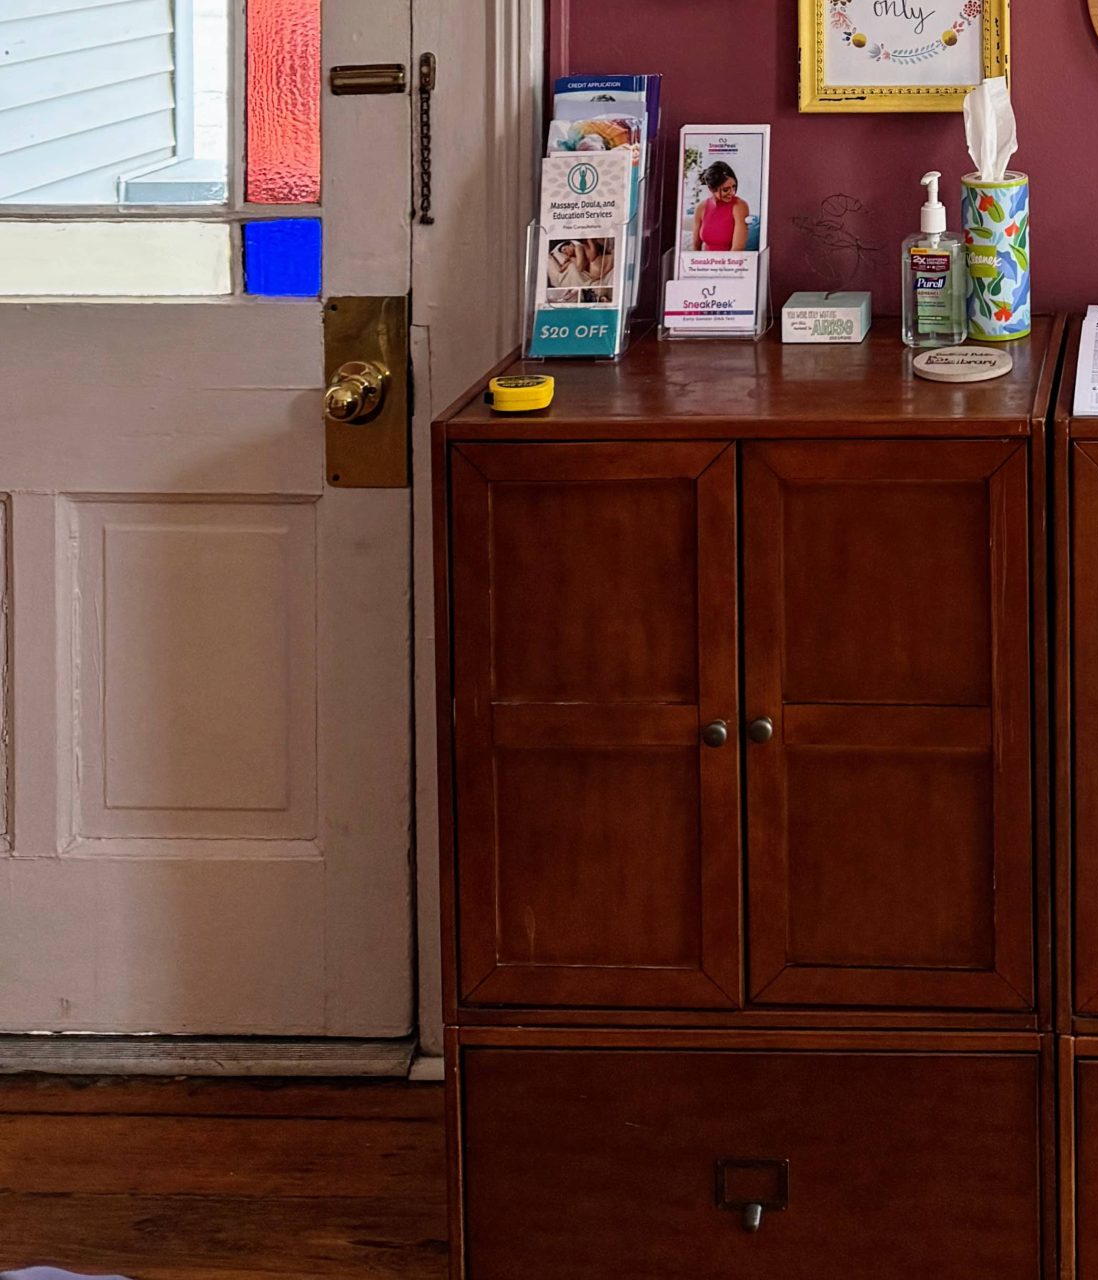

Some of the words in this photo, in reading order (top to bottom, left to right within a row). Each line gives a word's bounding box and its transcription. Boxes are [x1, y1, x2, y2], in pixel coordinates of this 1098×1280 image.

[550, 202, 580, 210] Massage,
[580, 200, 602, 208] Doula,
[602, 200, 616, 208] and
[552, 212, 585, 220] Education
[585, 211, 613, 219] Services
[967, 252, 1003, 268] Kleenex
[917, 277, 944, 288] Purell
[682, 299, 734, 309] SneakPeek
[540, 325, 570, 339] $20
[574, 325, 609, 338] OFF
